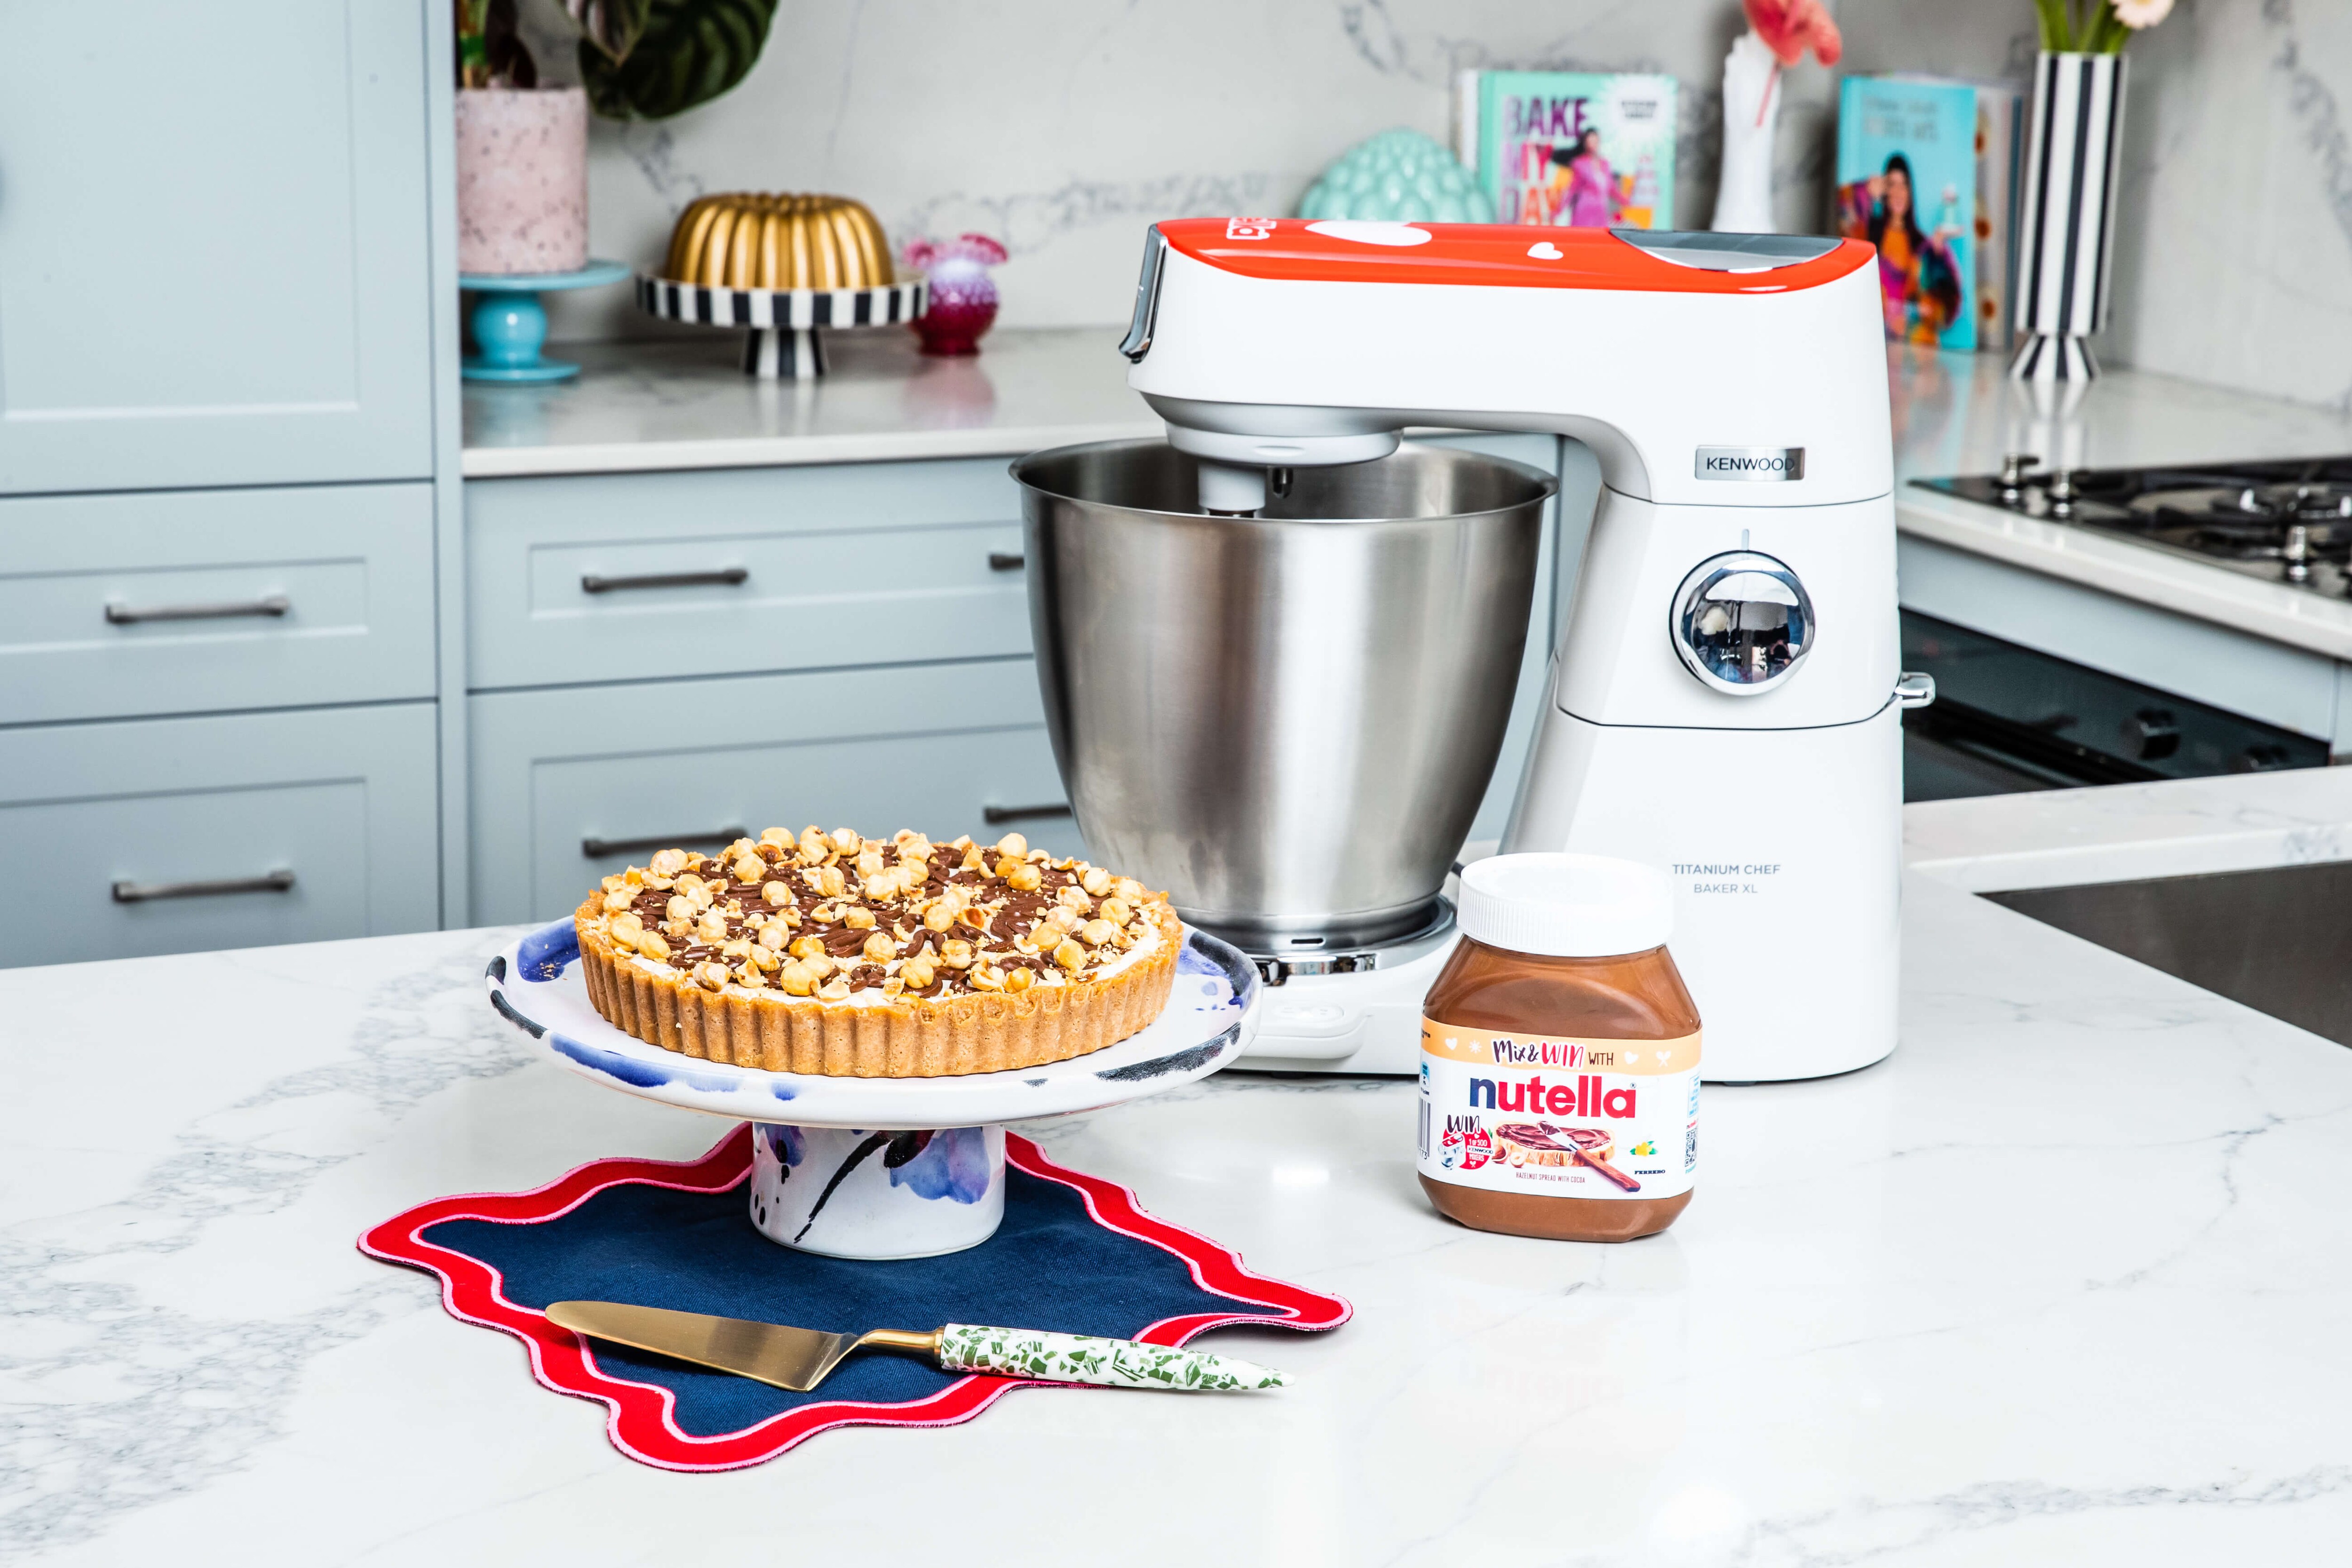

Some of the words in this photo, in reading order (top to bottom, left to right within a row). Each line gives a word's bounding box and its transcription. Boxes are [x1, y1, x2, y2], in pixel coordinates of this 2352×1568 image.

[1502, 97, 1588, 136] BAKE
[1707, 457, 1795, 471] KENWOOD
[1672, 865, 1739, 875] TITANIUM
[1744, 865, 1780, 875] CHEF
[1694, 884, 1738, 893] BAKER
[1742, 884, 1758, 893] XL
[1589, 1052, 1613, 1066] WITH
[1447, 1114, 1479, 1133] WIN
